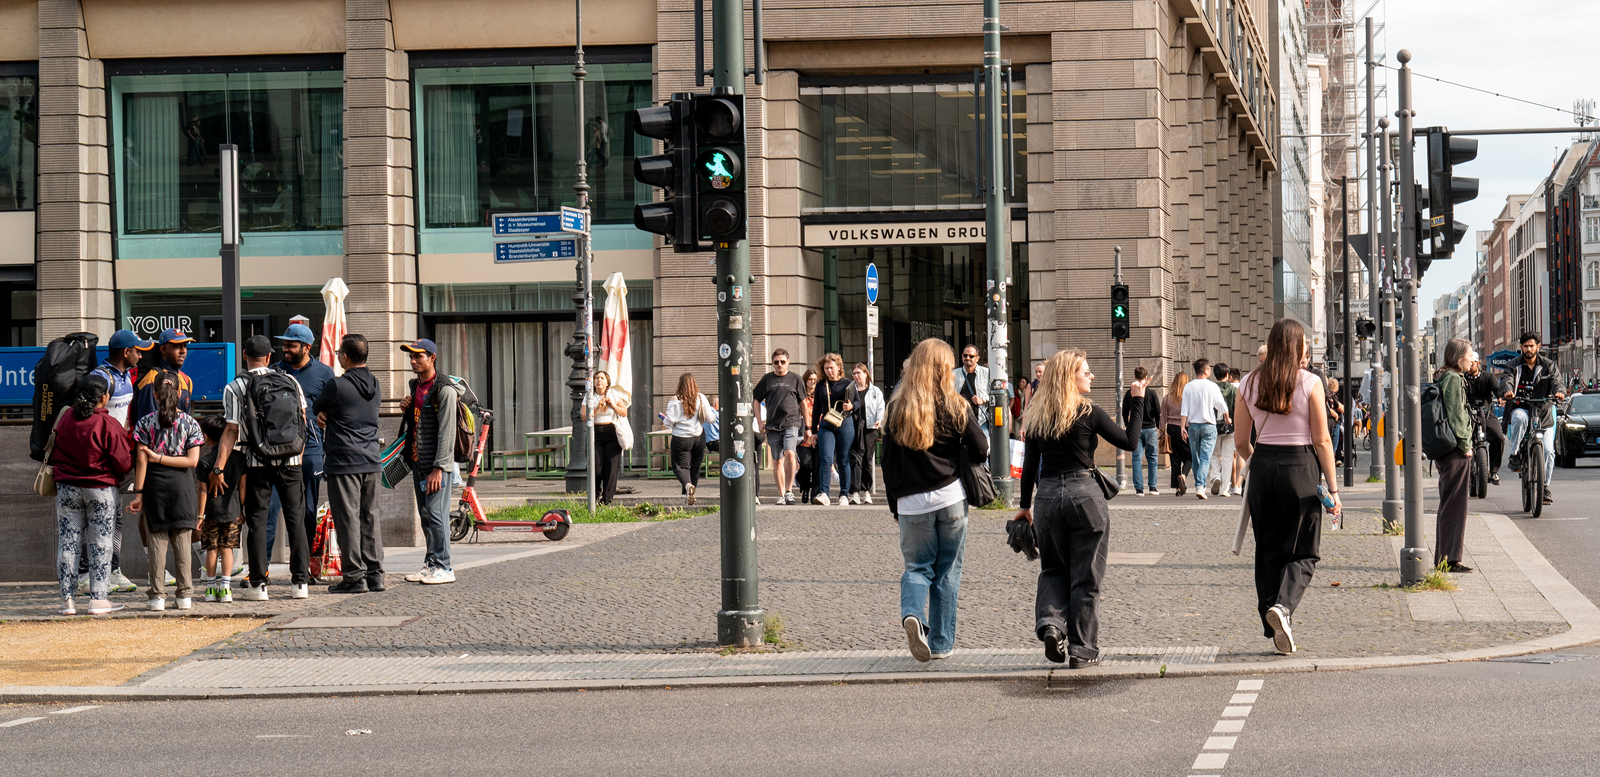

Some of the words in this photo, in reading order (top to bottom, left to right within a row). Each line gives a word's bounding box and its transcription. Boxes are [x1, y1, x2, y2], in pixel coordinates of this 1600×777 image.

[829, 228, 938, 240] VOLKSWAGEN
[947, 227, 987, 238] GROU
[127, 315, 193, 334] YOUR
[0, 365, 36, 386] nte
[40, 383, 49, 422] CHANGER
[46, 391, 54, 415] GAME
